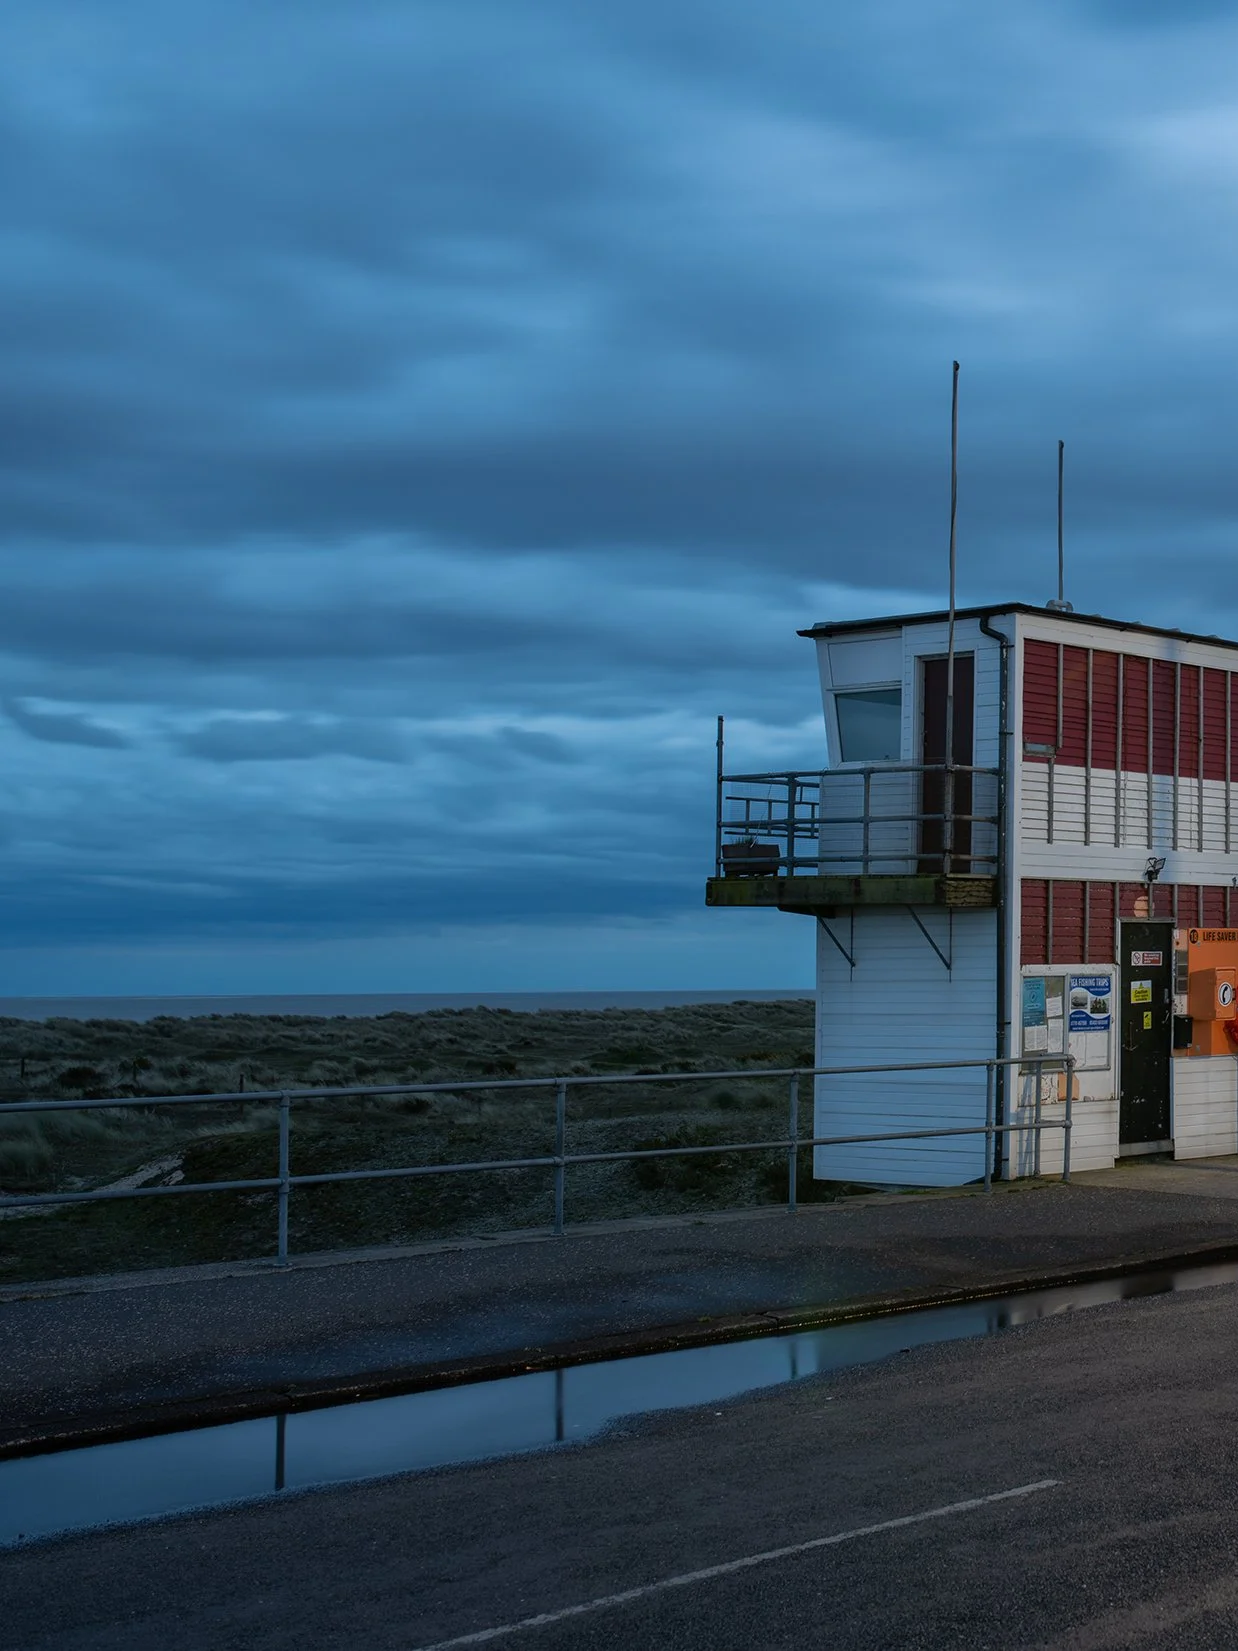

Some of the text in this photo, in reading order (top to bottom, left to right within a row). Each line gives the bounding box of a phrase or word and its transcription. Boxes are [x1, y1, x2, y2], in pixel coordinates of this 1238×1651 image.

[1202, 932, 1216, 941] LIFE
[1217, 932, 1236, 941] SAVER
[1079, 978, 1096, 987] FISHING
[1096, 978, 1109, 986] TRIPS
